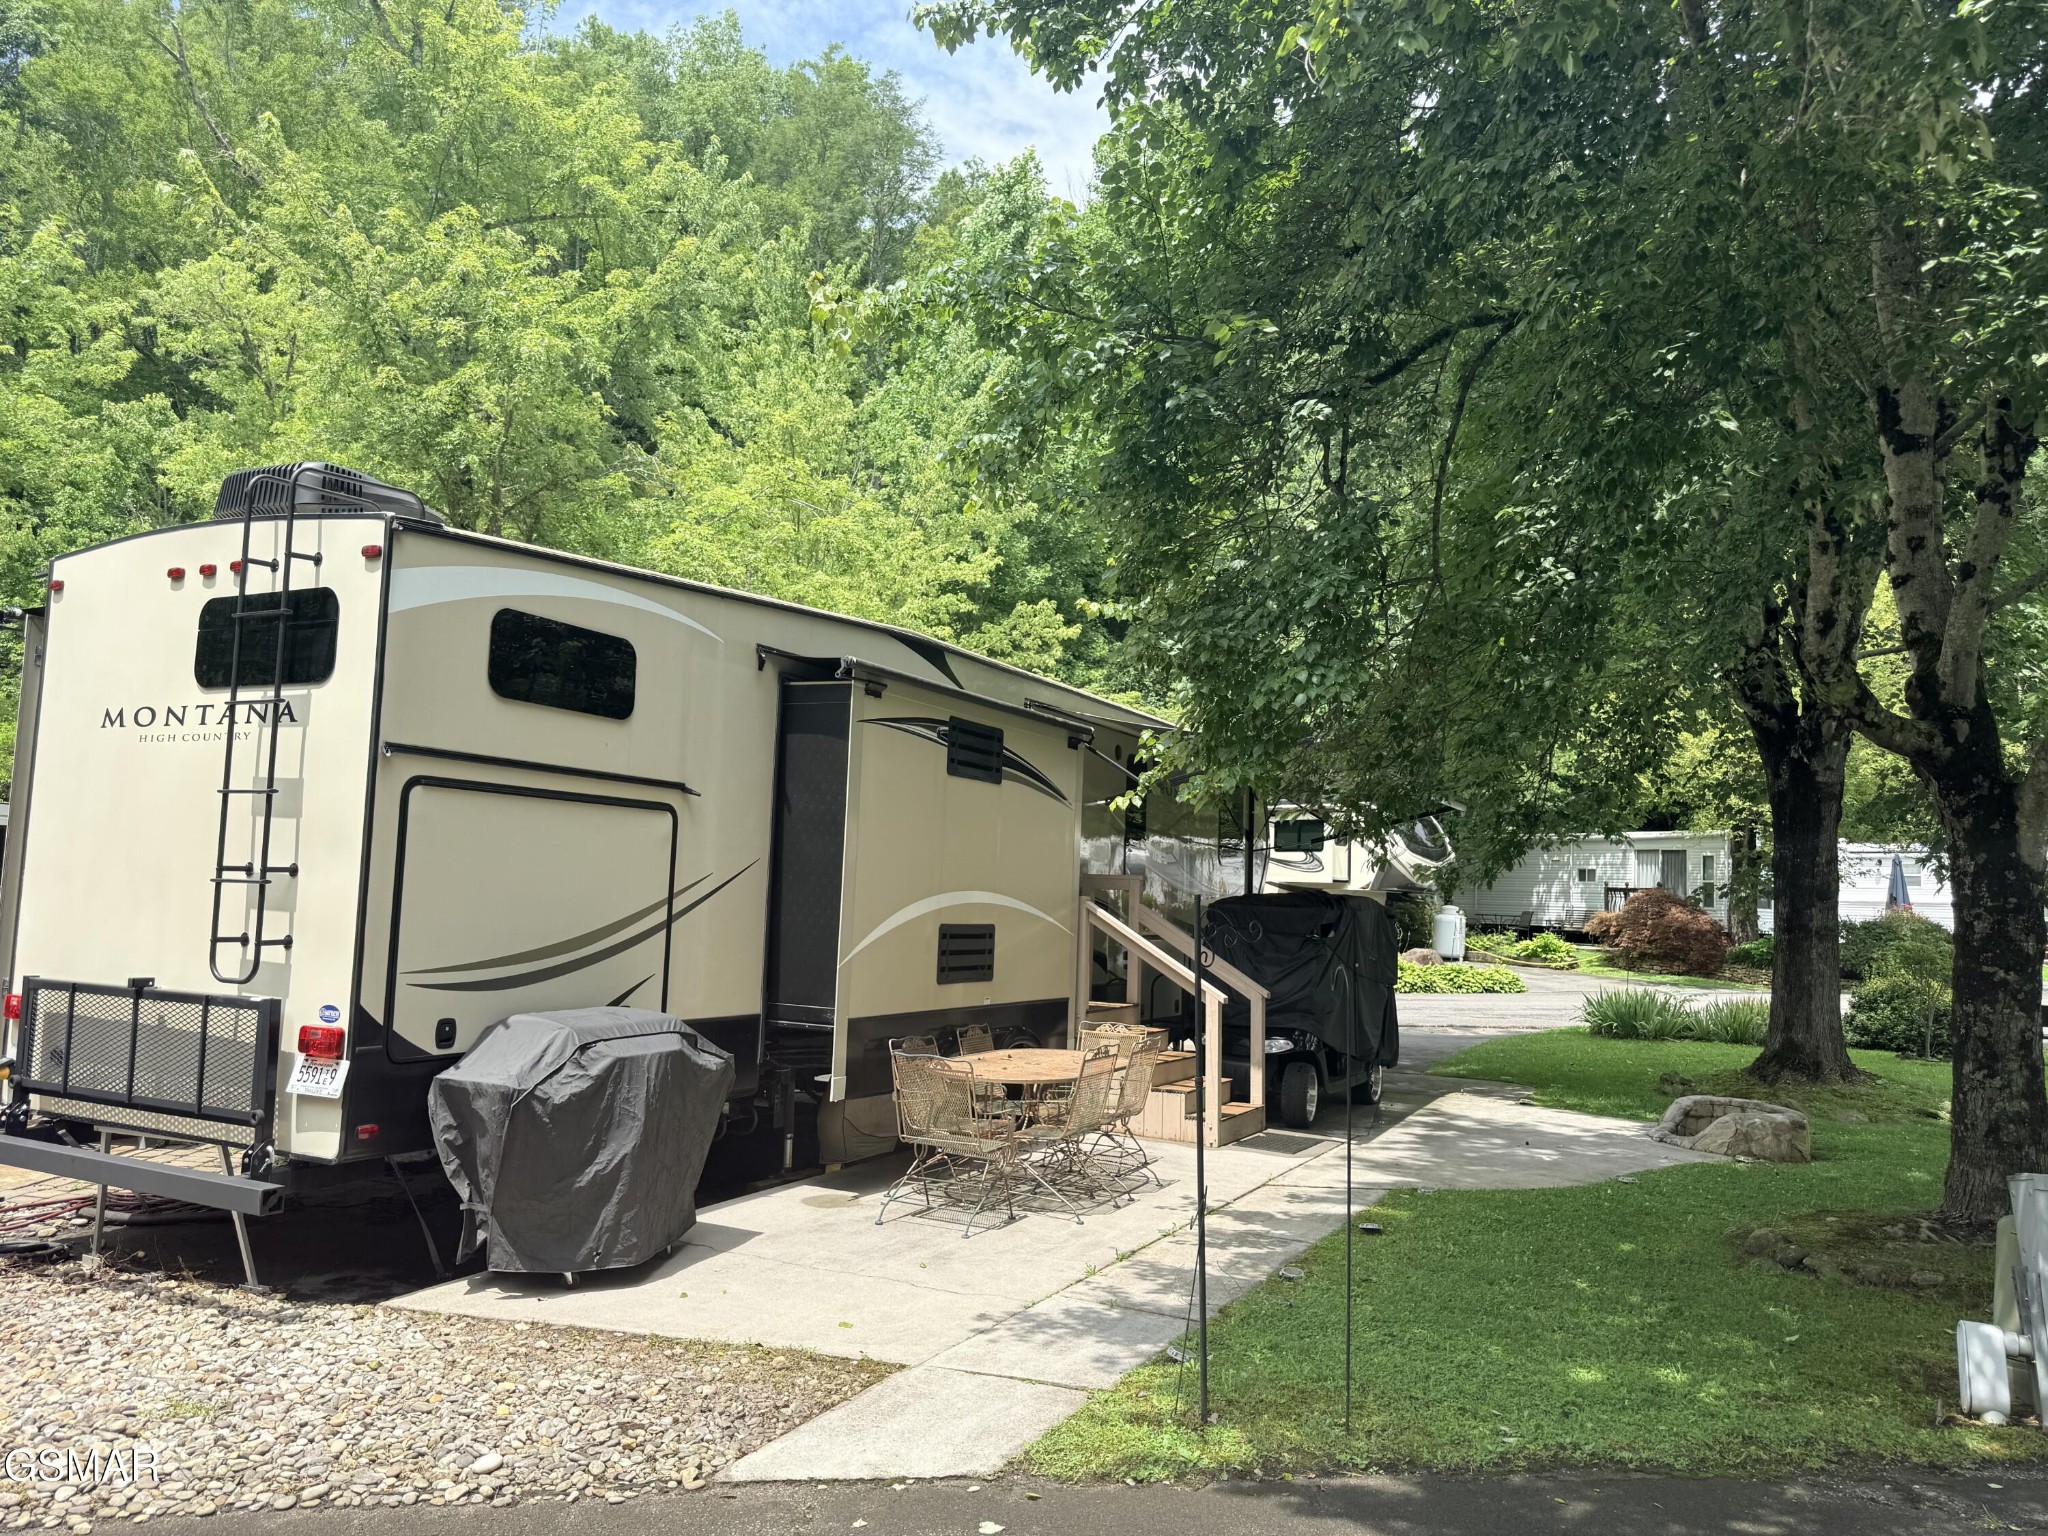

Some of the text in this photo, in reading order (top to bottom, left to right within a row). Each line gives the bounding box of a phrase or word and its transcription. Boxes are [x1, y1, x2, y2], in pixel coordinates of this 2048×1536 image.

[100, 700, 298, 728] MONTANA
[139, 731, 251, 743] HIGH COUNRY
